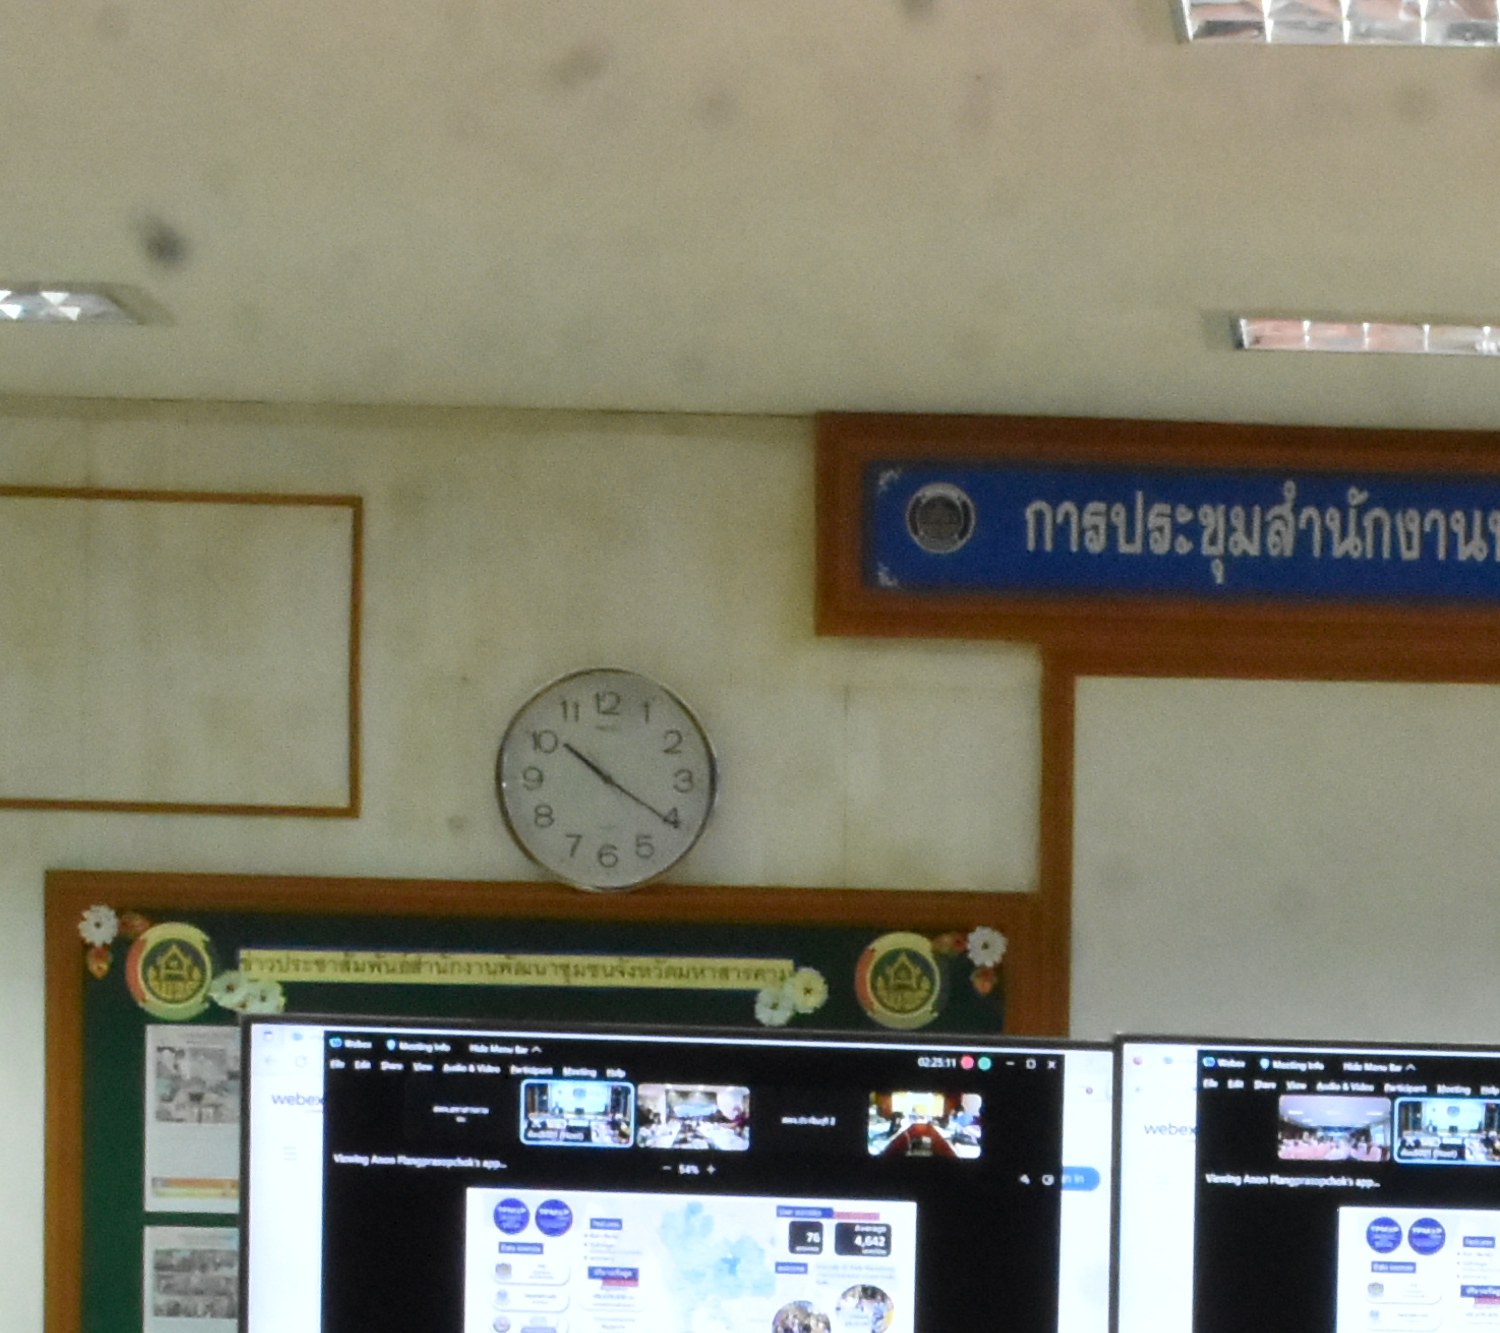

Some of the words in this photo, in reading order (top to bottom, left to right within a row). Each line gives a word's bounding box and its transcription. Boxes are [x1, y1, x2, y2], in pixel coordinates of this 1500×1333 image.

[562, 701, 578, 721] 11
[596, 692, 620, 715] 12
[532, 730, 558, 753] 10
[664, 730, 682, 754] 2
[523, 767, 543, 790] 9
[673, 769, 693, 793] 3
[534, 805, 553, 828] 8
[662, 807, 679, 828] 4
[566, 834, 582, 856] 7
[597, 844, 618, 867] 6
[635, 835, 654, 858] 5
[1217, 1058, 1246, 1069] Webex
[1272, 1060, 1306, 1072] Meeting
[271, 1093, 324, 1108] webex
[1143, 1122, 1197, 1137] webex
[806, 1232, 821, 1244] 76
[854, 1235, 887, 1249] 4,642
